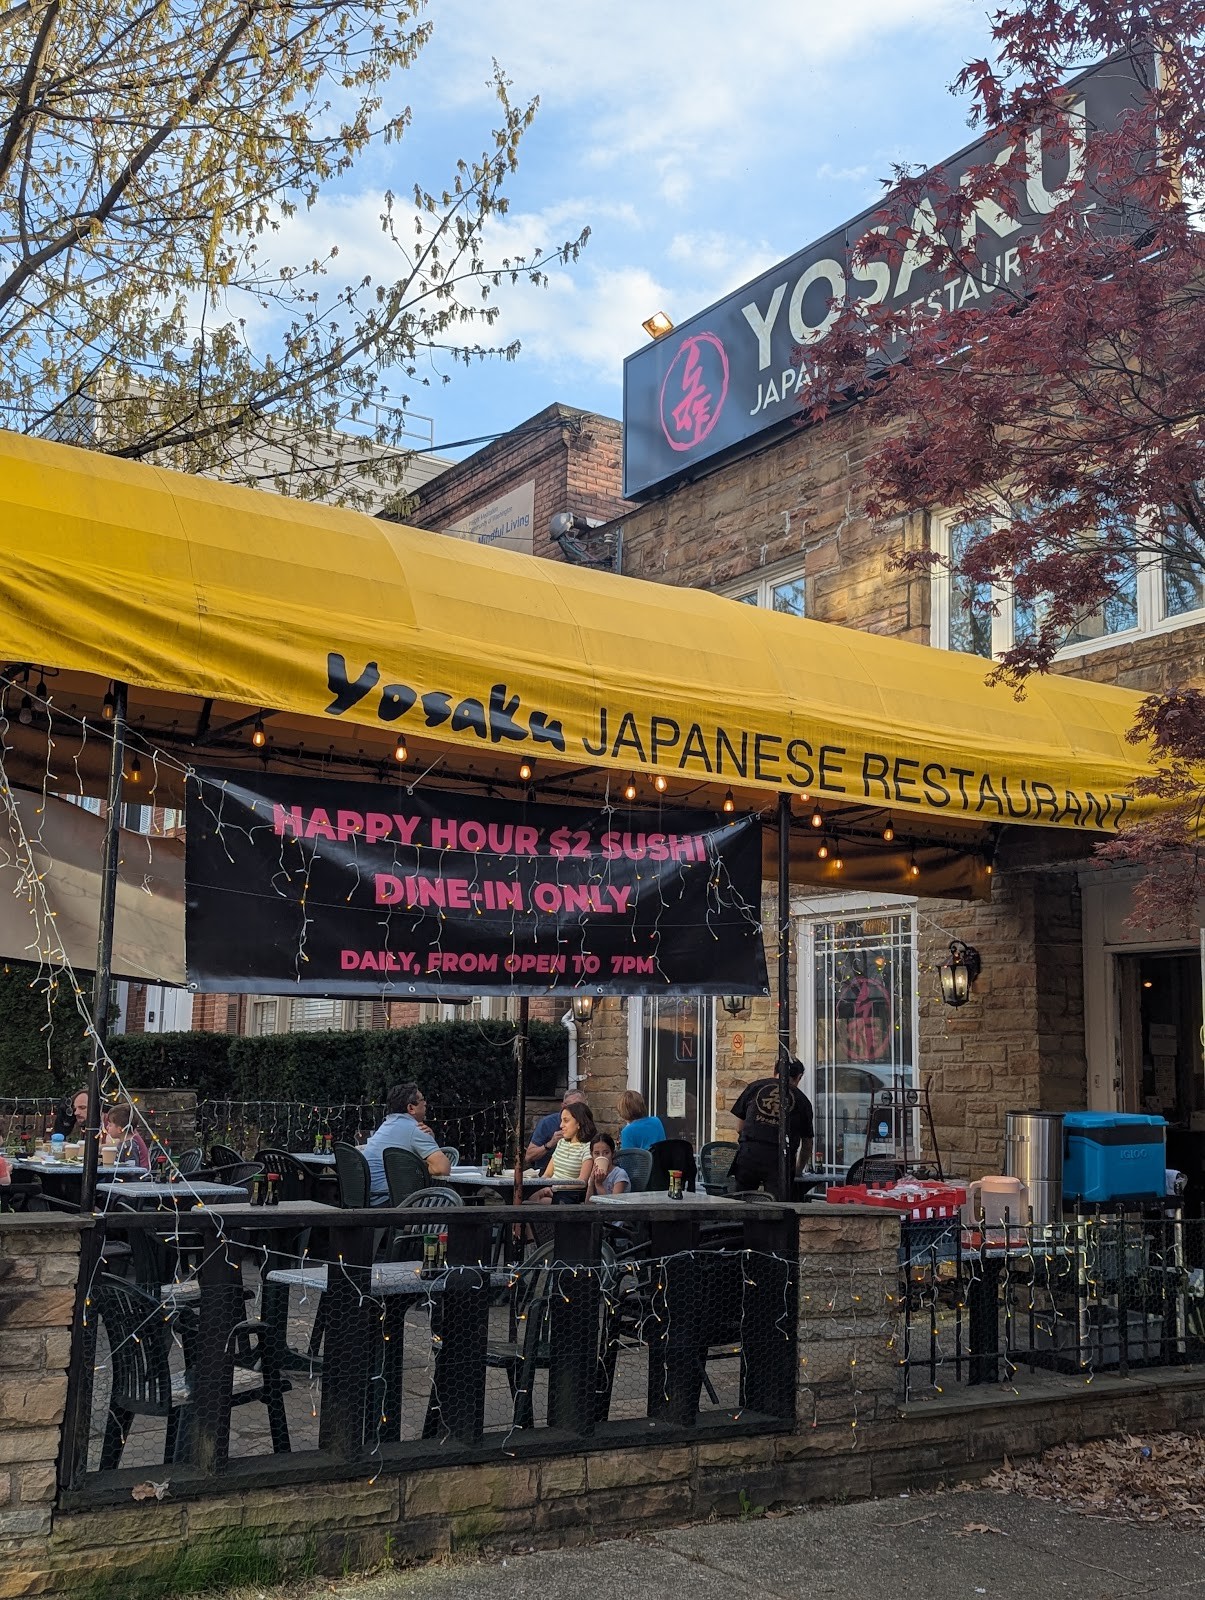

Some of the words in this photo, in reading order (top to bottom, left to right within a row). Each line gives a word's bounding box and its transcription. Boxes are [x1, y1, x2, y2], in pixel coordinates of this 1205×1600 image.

[741, 100, 1086, 371] YOSAKU
[505, 514, 530, 533] Living
[324, 652, 566, 751] Yosaku
[582, 707, 849, 792] JAPANESE
[862, 752, 1134, 829] RESTAURANT
[273, 804, 420, 846] HAPPY
[432, 817, 539, 855] HOUR
[550, 825, 593, 861] $2
[601, 832, 707, 862] SUSHI
[375, 873, 524, 911] DINE-IN
[534, 882, 631, 913] ONLY
[340, 950, 420, 975] DAILY,
[428, 953, 498, 972] FROM
[504, 953, 565, 973] OPEN
[572, 954, 601, 973] TO
[611, 955, 655, 974] 7PM
[1120, 1149, 1148, 1159] IGLOO
